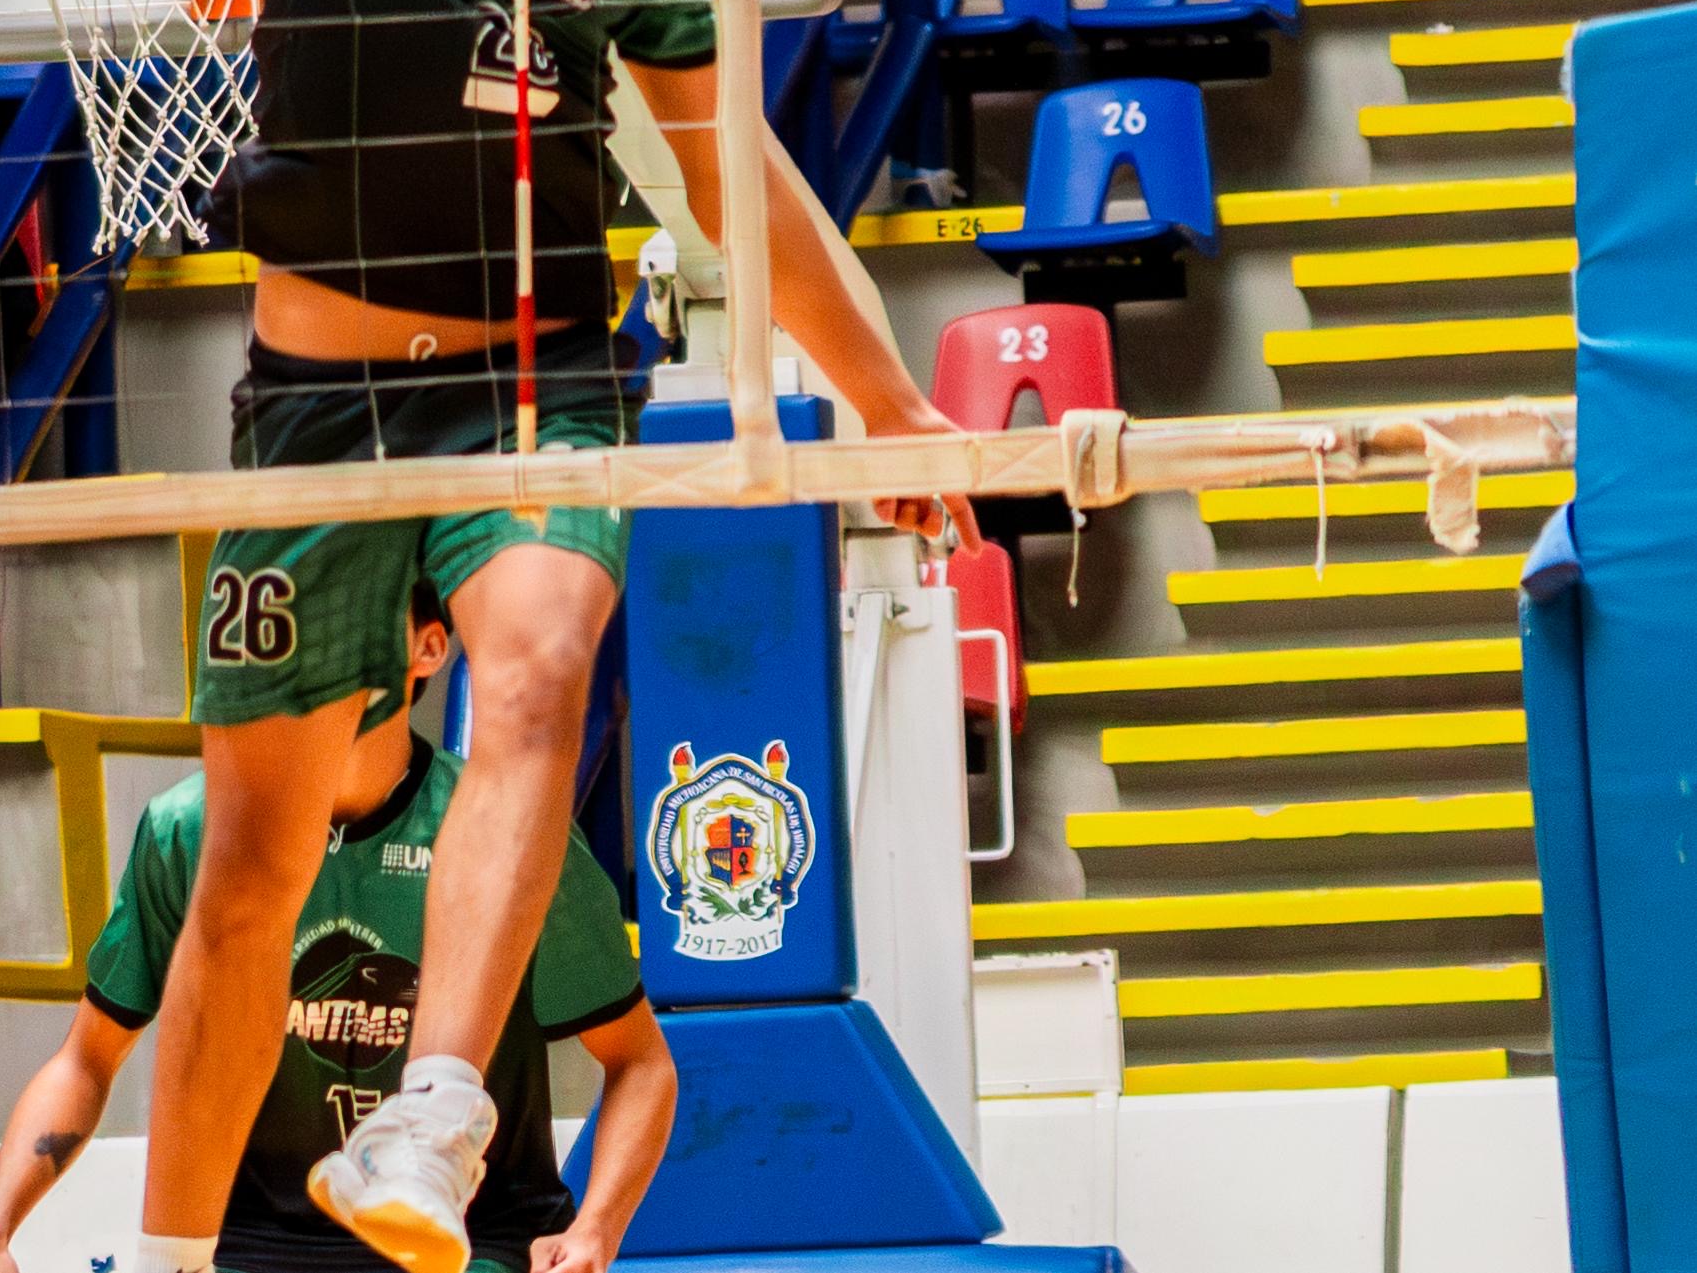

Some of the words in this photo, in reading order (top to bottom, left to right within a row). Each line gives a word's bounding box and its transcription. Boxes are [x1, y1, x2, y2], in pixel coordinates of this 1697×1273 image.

[1102, 100, 1147, 136] 26
[998, 326, 1049, 364] 23
[206, 566, 297, 668] 26
[680, 928, 781, 956] 1917-2017
